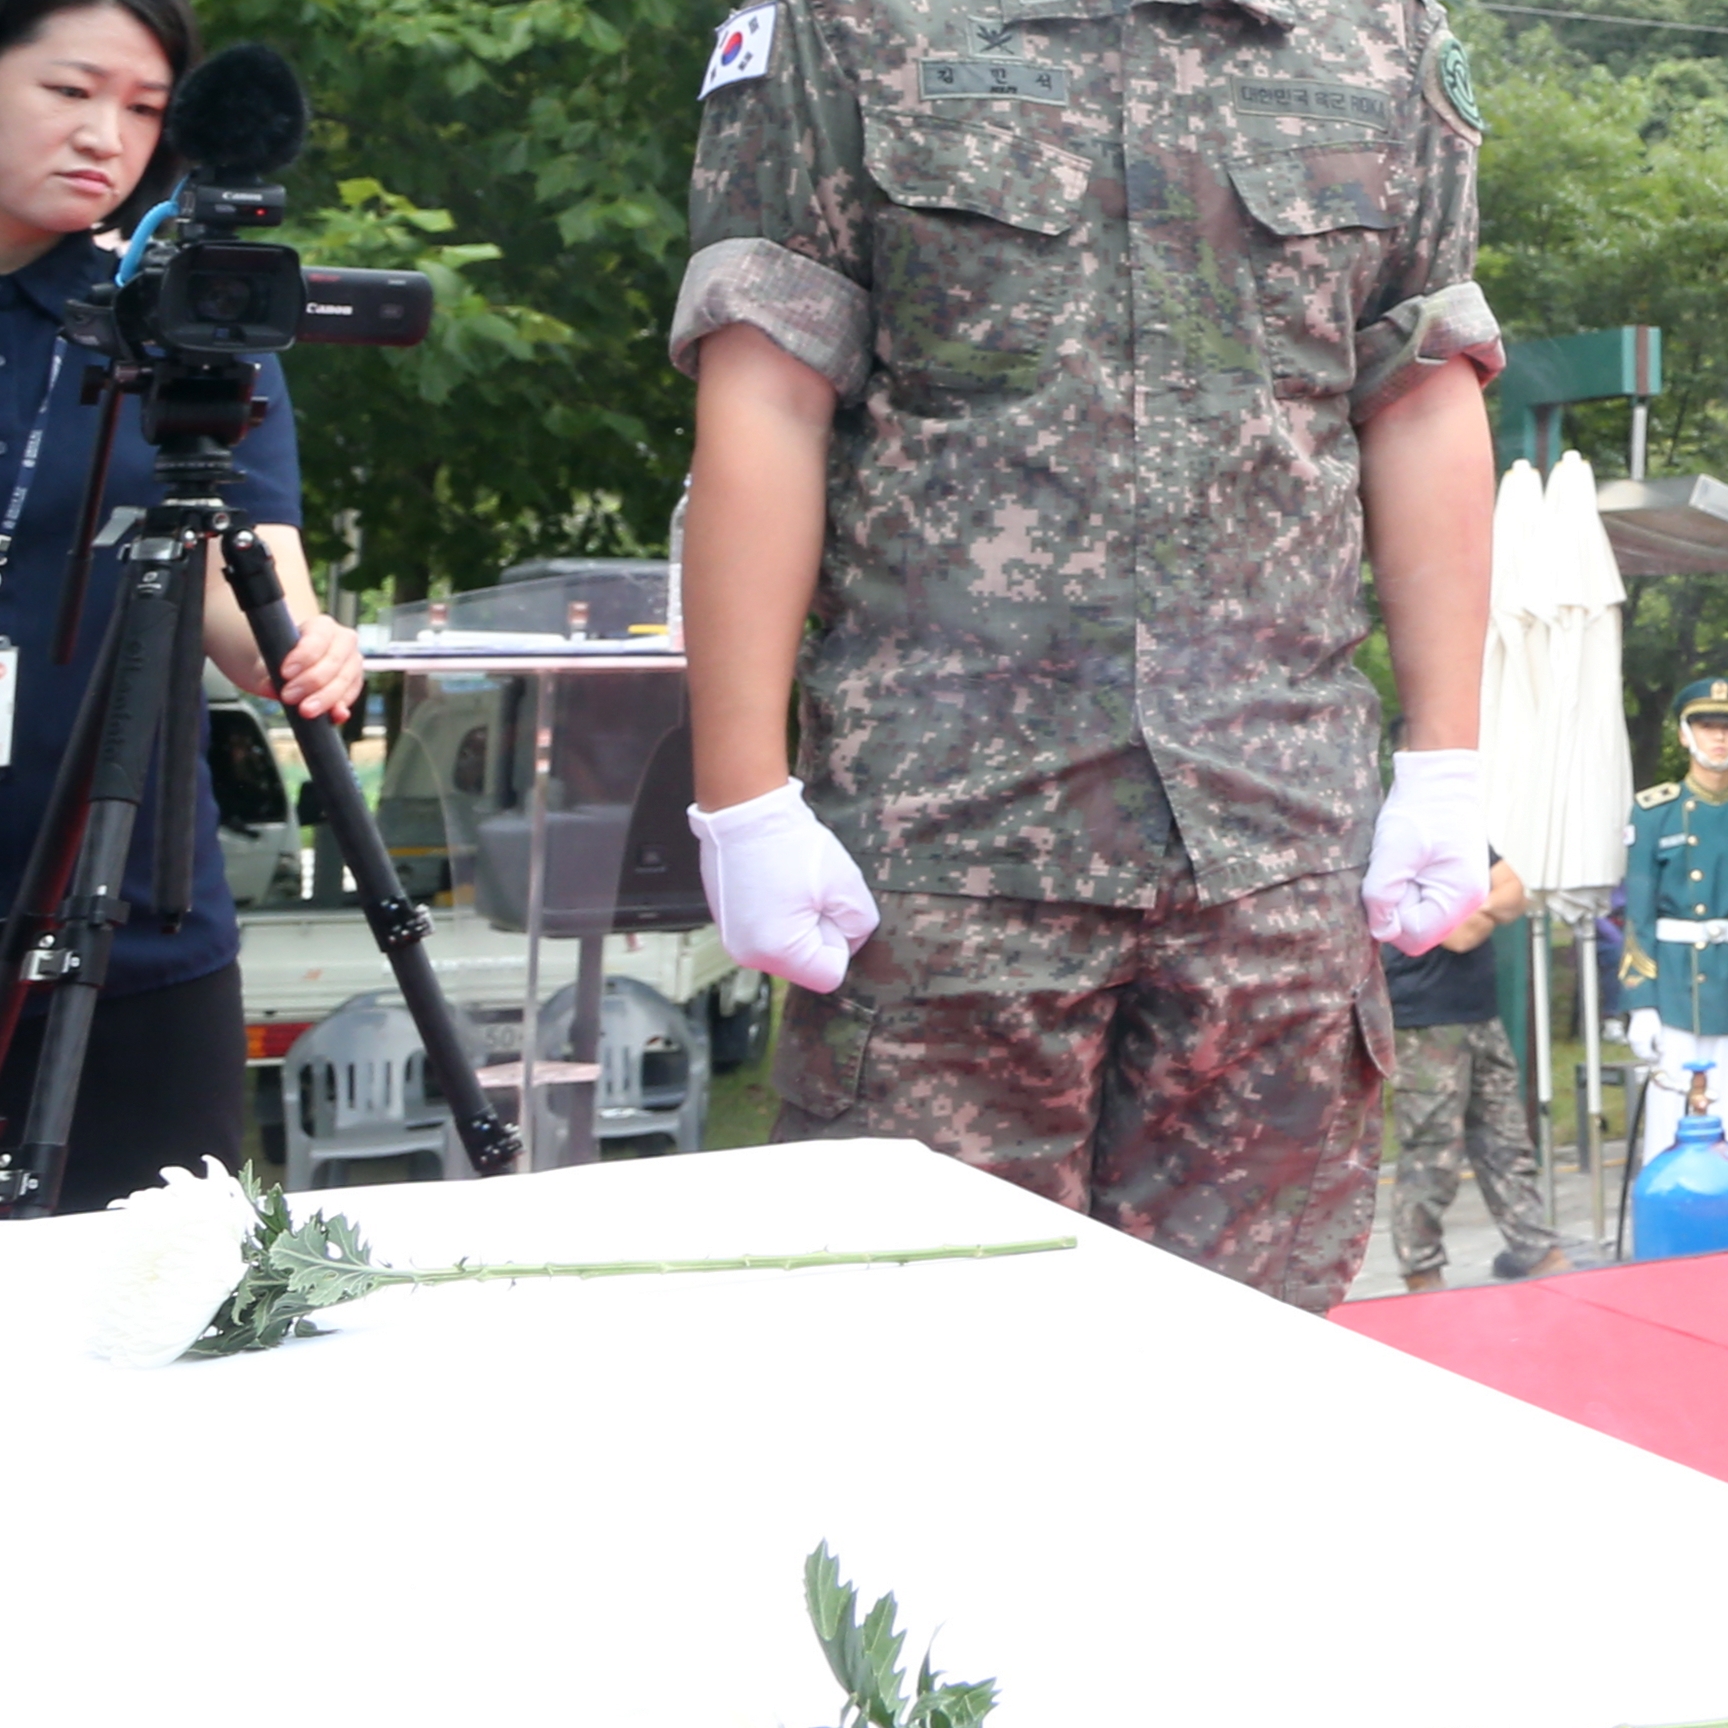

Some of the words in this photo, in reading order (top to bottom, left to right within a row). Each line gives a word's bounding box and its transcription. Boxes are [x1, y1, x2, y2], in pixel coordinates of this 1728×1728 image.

[1241, 85, 1309, 107] 대한민국
[1314, 91, 1346, 111] 육군
[306, 302, 353, 316] Canon
